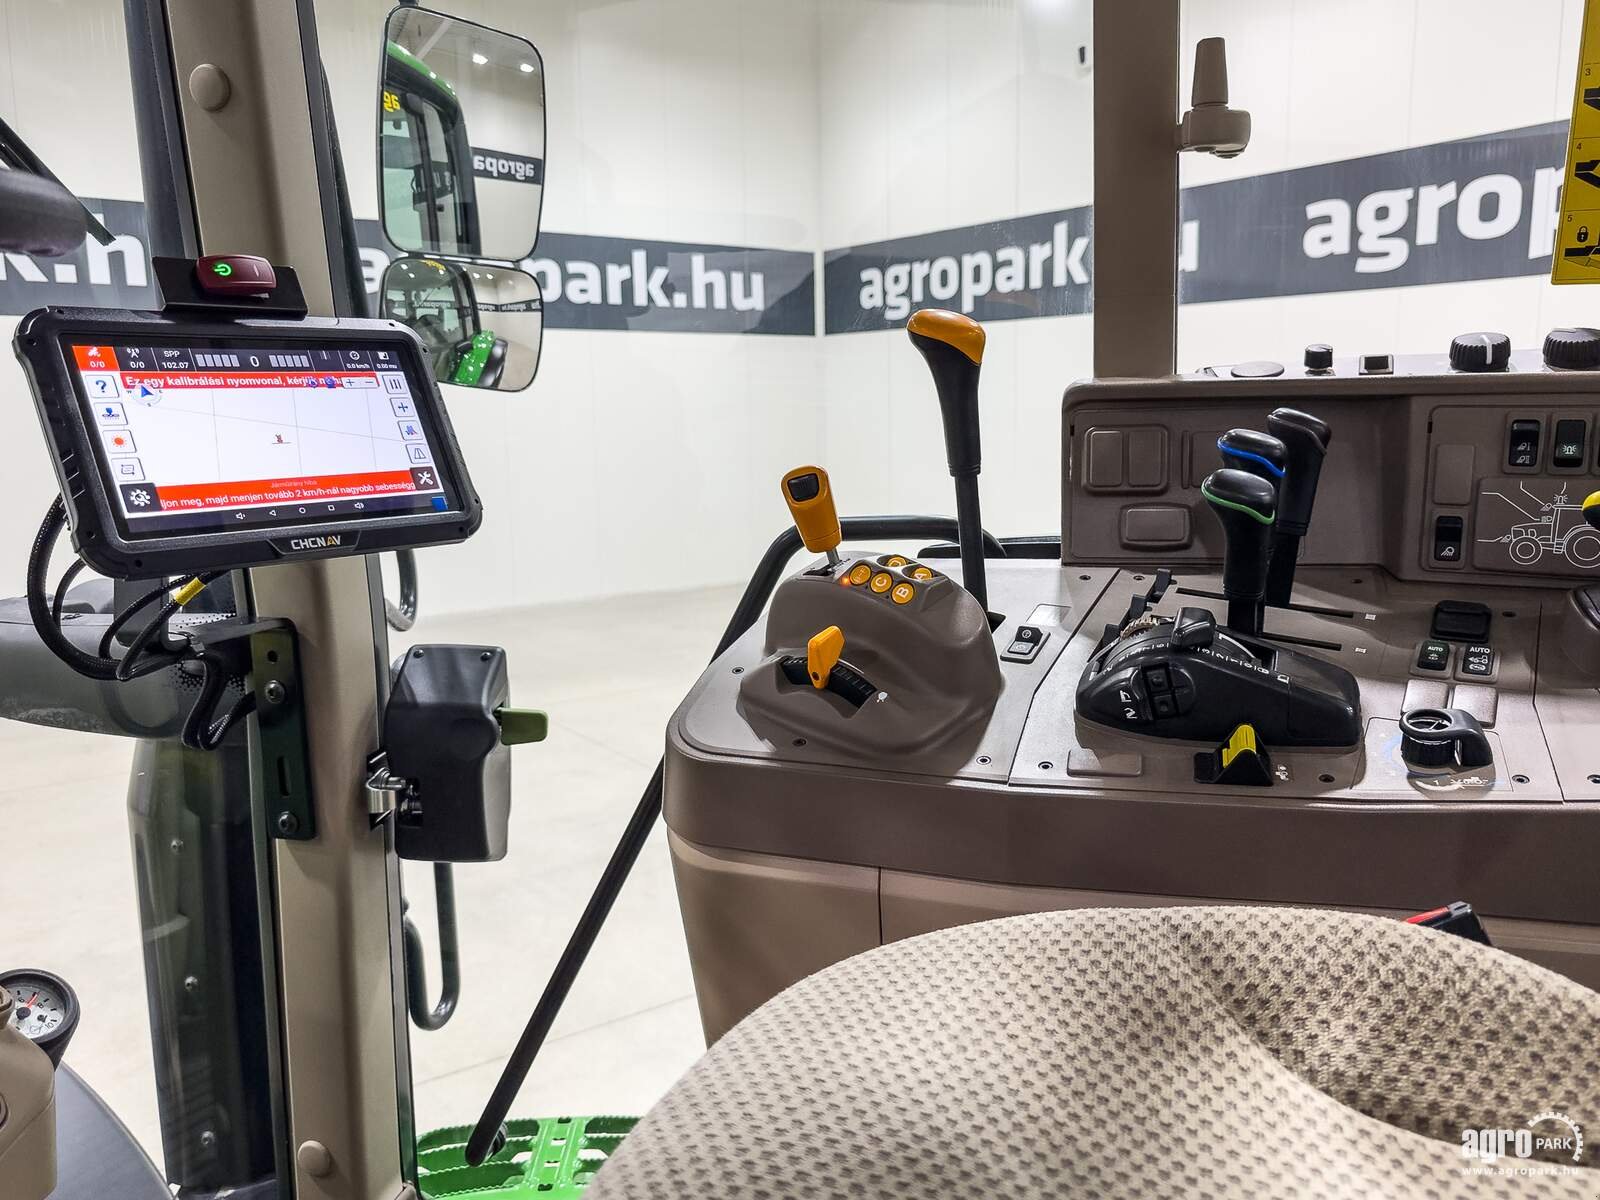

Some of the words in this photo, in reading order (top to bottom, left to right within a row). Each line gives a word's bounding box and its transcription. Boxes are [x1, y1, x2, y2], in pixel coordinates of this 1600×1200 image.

[1585, 68, 1591, 76] 3
[1576, 142, 1582, 151] 4
[163, 350, 180, 358] SPP
[90, 360, 105, 368] 0/0
[130, 361, 145, 369] 0/0
[162, 361, 189, 369] 102.07
[250, 355, 260, 368] 0
[126, 376, 140, 386] Ez
[143, 378, 164, 388] egy
[167, 376, 225, 386] kalibrálási
[227, 377, 286, 388] nyomvonal,
[180, 498, 205, 507] meg,
[206, 494, 229, 505] majd
[230, 493, 263, 504] menjen
[264, 490, 295, 500] tovább
[296, 489, 303, 498] 2
[303, 487, 339, 497] km/h-nál
[340, 484, 375, 495] nagyobb
[291, 535, 341, 550] CHCNAV
[875, 576, 887, 587] C
[896, 586, 909, 598] B
[1469, 646, 1491, 654] AUTO
